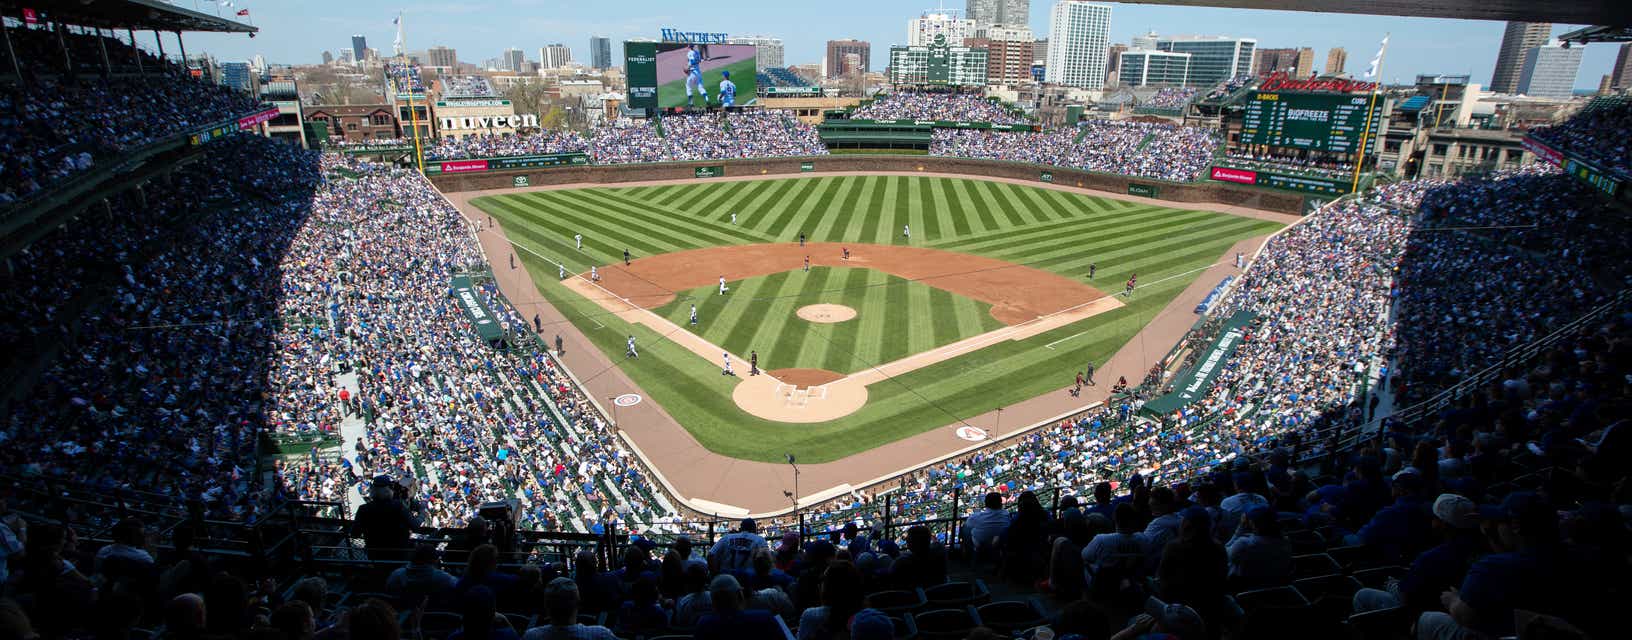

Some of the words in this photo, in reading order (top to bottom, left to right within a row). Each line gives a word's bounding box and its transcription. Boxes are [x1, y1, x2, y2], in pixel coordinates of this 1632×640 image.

[661, 28, 728, 43] WINTRUST
[1258, 71, 1377, 92] Budweiser
[1288, 108, 1328, 117] BIOFREEZE
[440, 113, 540, 130] nuveen
